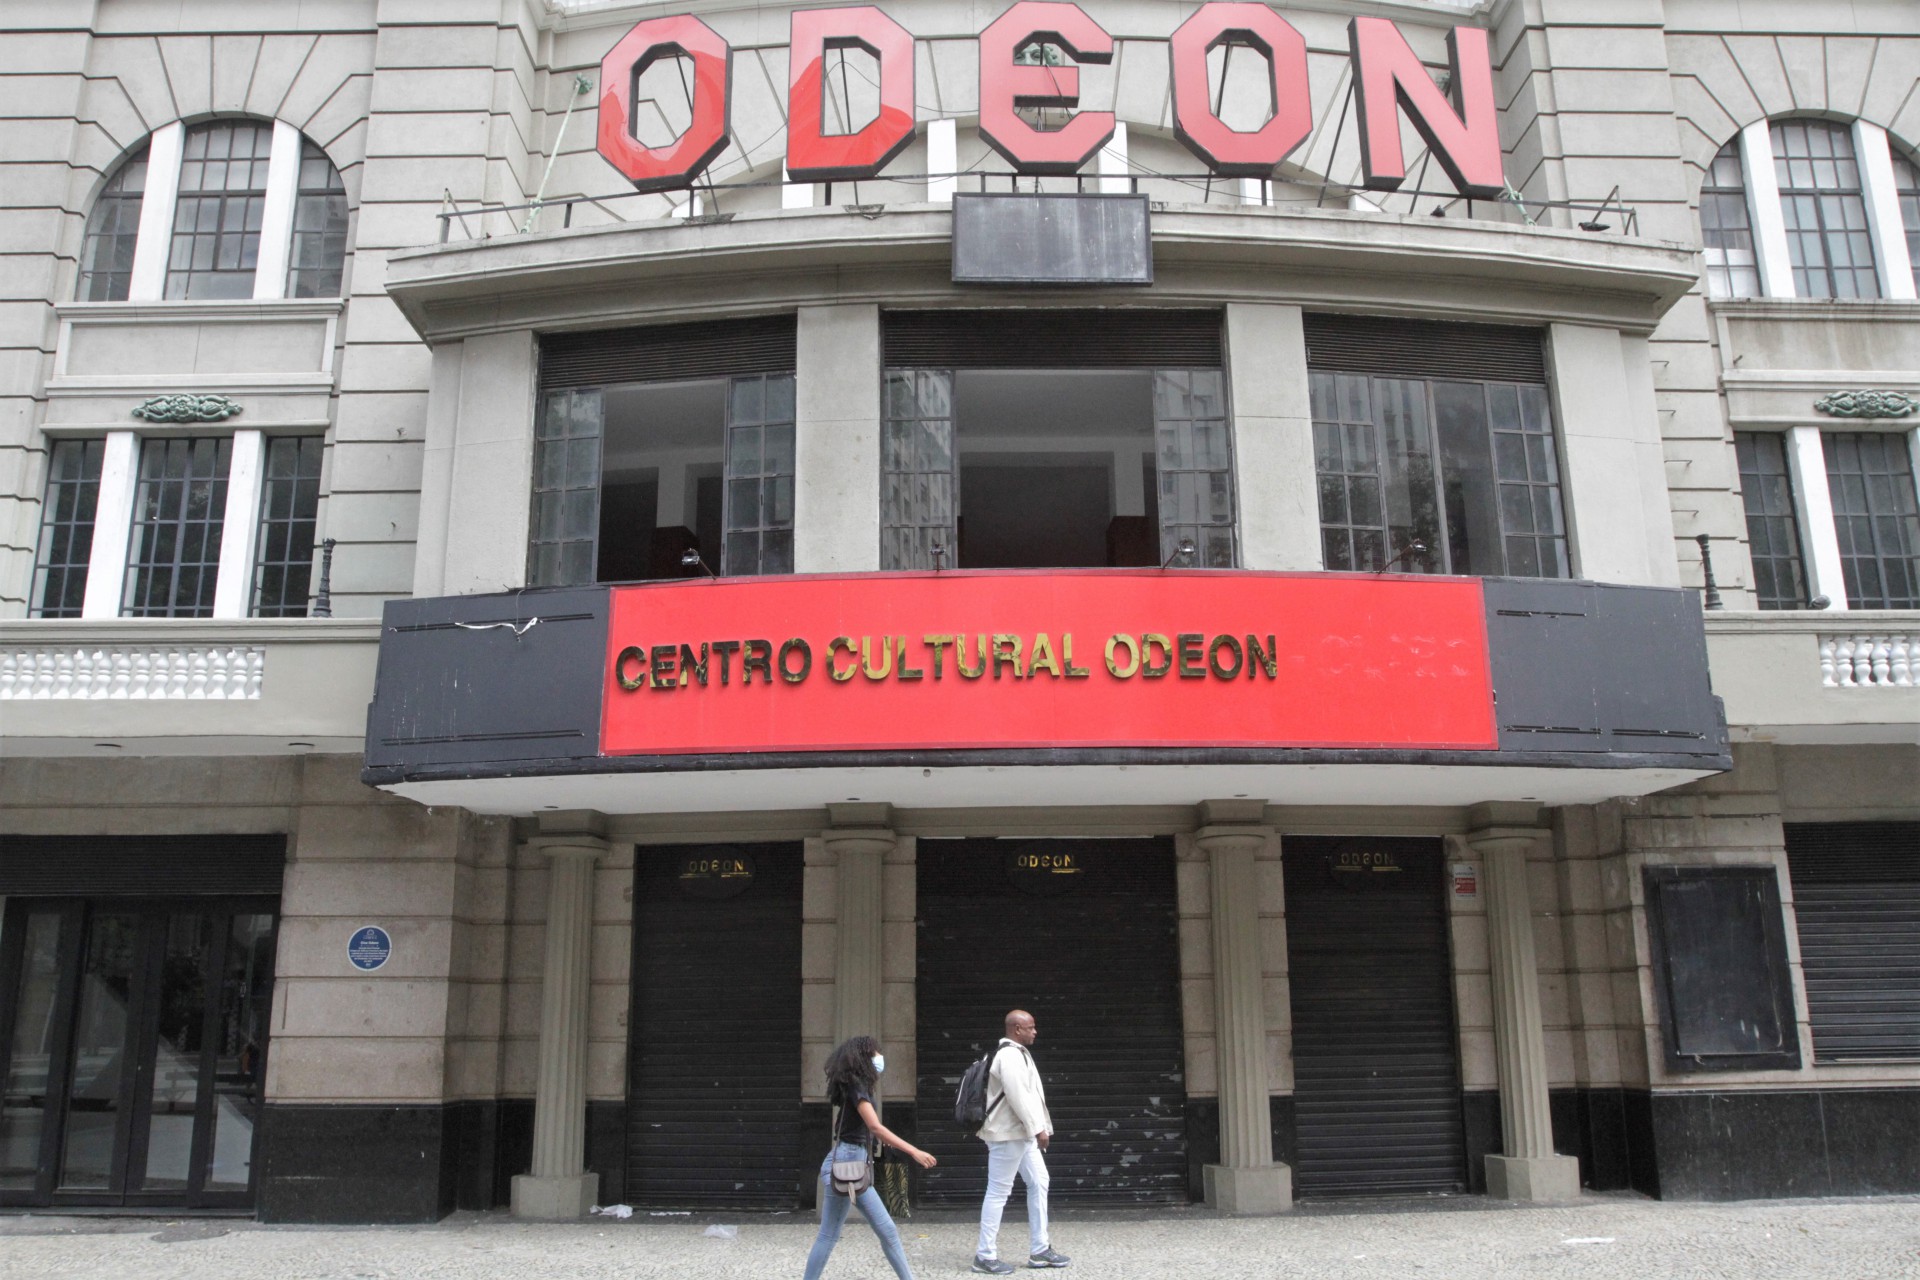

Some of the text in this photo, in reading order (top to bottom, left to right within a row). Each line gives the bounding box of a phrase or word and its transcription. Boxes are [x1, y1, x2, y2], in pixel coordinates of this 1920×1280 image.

[597, 1, 1505, 198] ODEON
[614, 632, 1278, 691] CENTRO CULTURAL ODEON
[1017, 854, 1074, 868] ODEON
[1340, 852, 1393, 865] ODEON
[688, 859, 744, 873] ODEON
